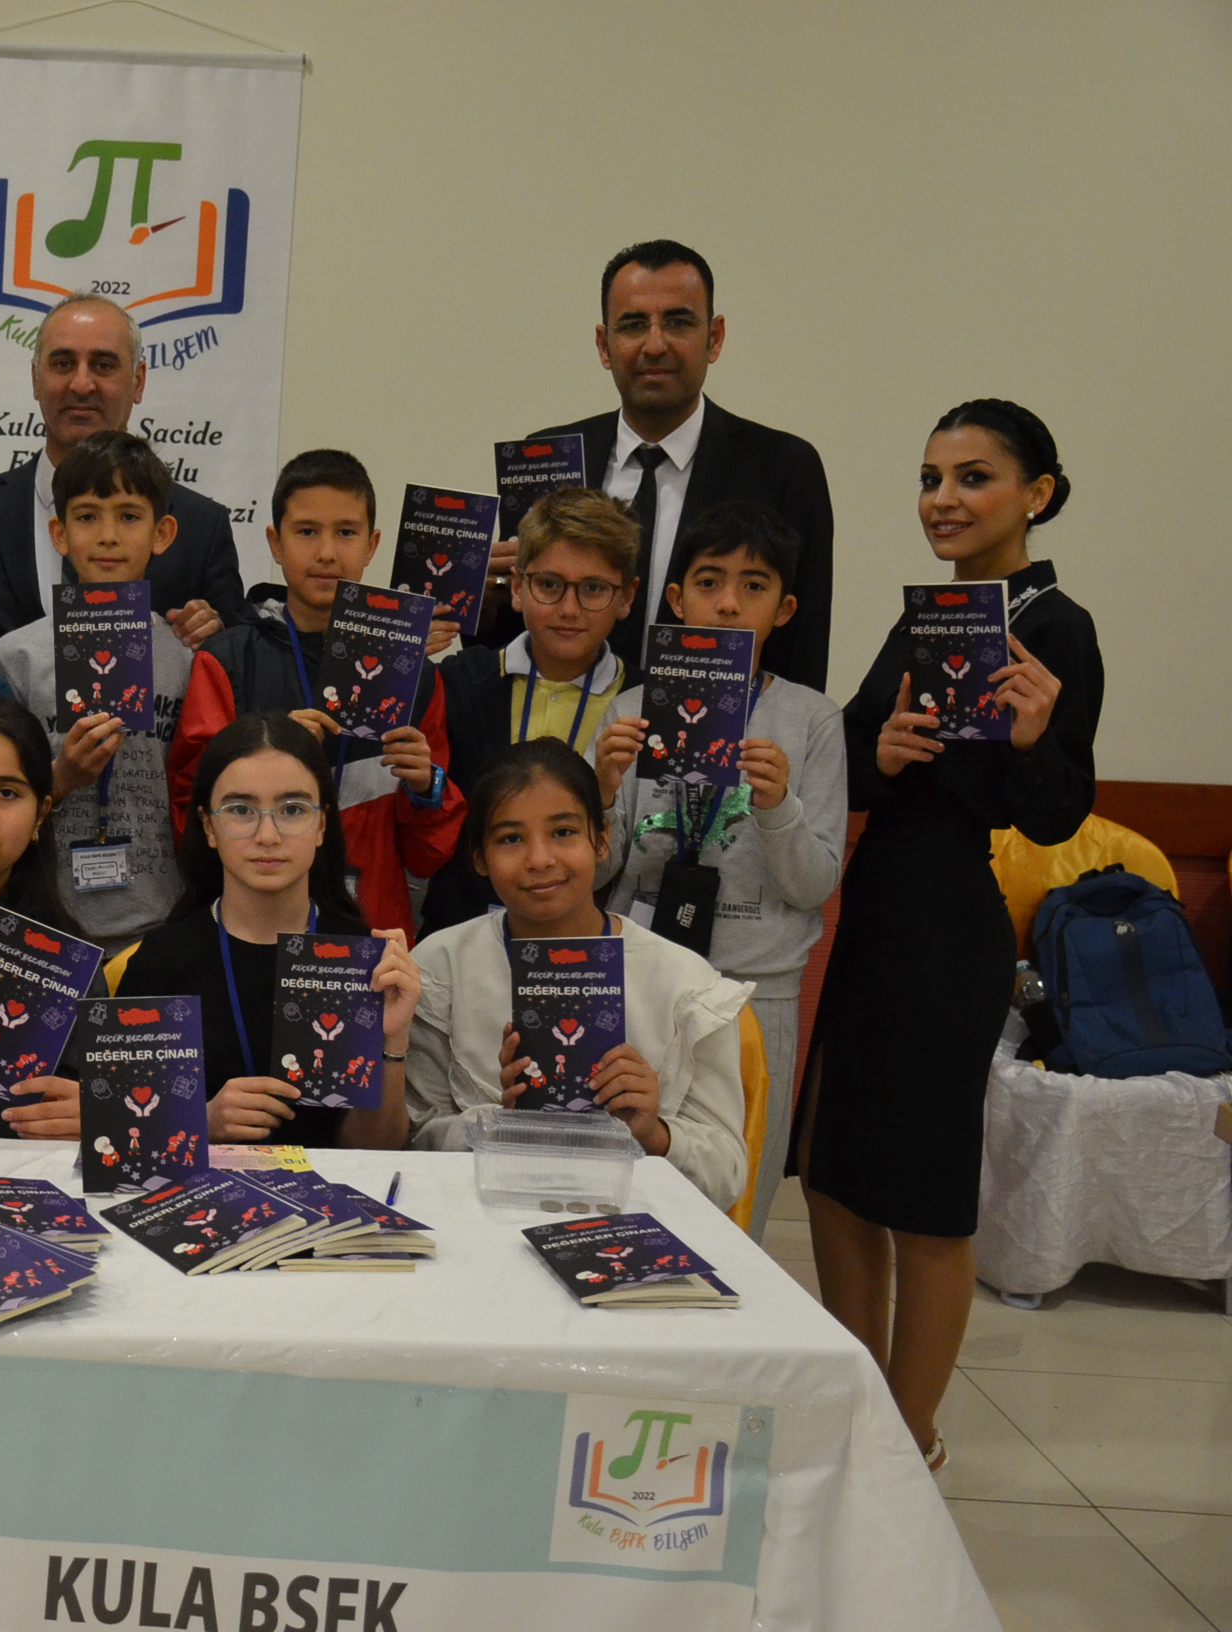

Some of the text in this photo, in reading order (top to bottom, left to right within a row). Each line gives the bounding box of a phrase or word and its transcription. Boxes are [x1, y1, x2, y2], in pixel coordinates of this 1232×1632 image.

[91, 281, 130, 295] 2022
[139, 418, 223, 445] Sacide
[123, 749, 153, 762] BOYS
[722, 903, 760, 914] DANGEROUS
[281, 978, 341, 990] DEĞERLER
[518, 985, 580, 995] DEĞERLER
[86, 1049, 152, 1061] DEĞERLER
[632, 1492, 655, 1500] 2022
[578, 1513, 604, 1537] Kula
[44, 1555, 408, 1632] KULA BSFK
